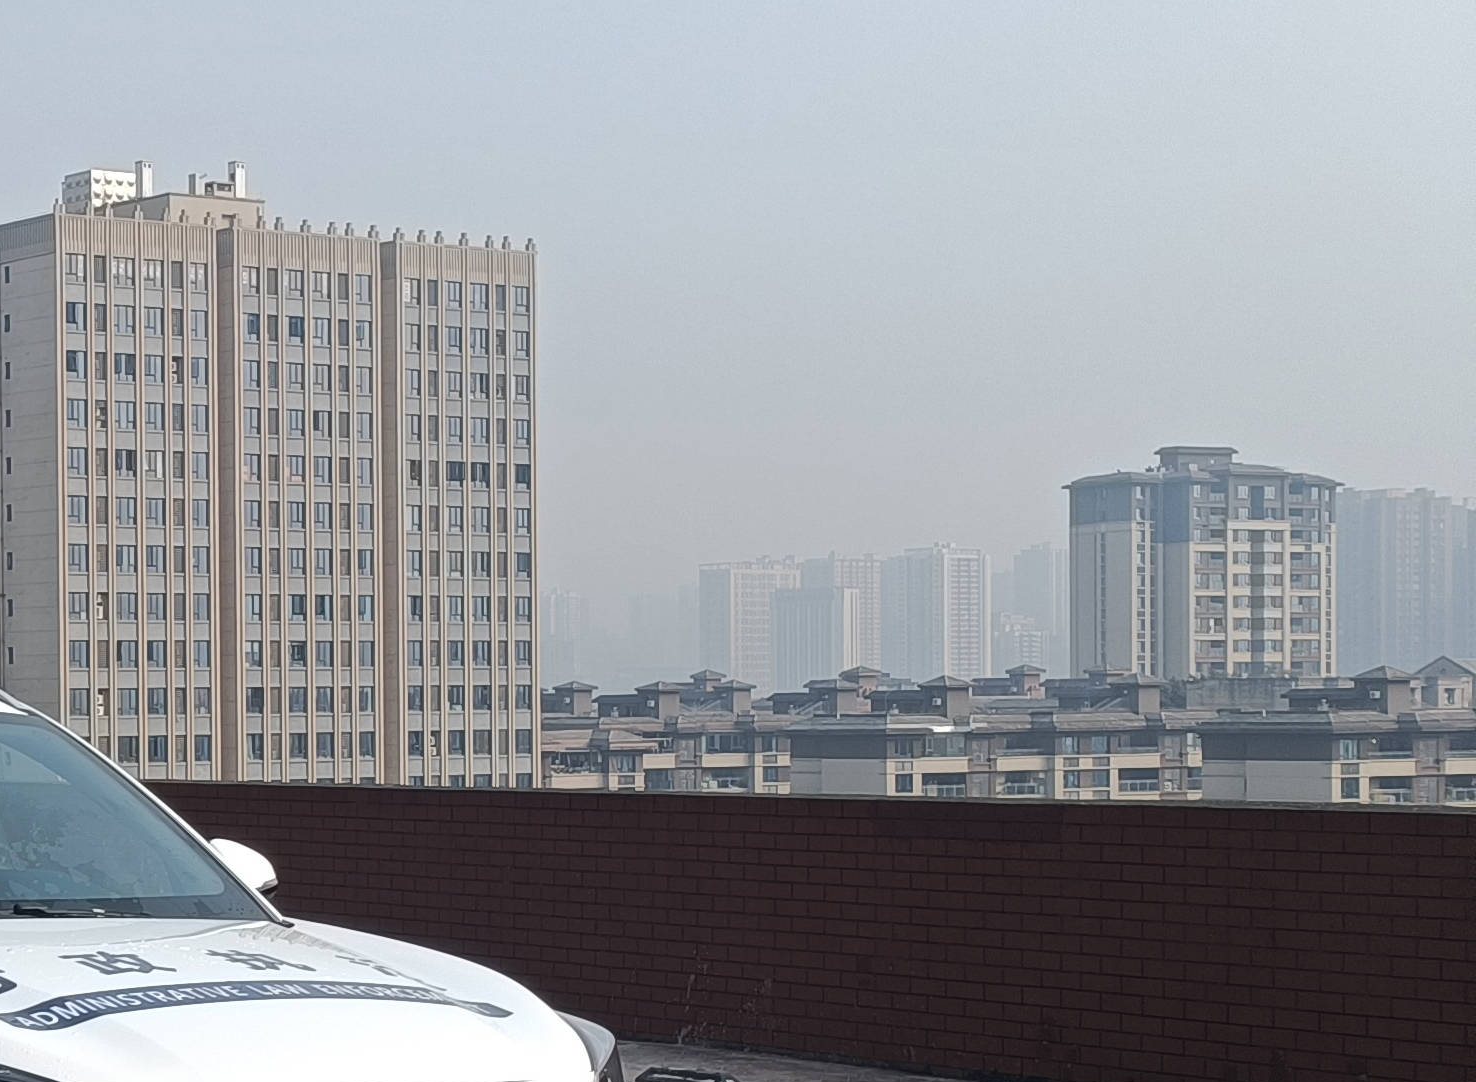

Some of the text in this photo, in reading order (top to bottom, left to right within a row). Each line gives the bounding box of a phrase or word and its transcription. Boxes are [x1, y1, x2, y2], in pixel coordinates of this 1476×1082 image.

[14, 982, 492, 1029] ADMINISTRATIVE LAW ENFORCEMT
